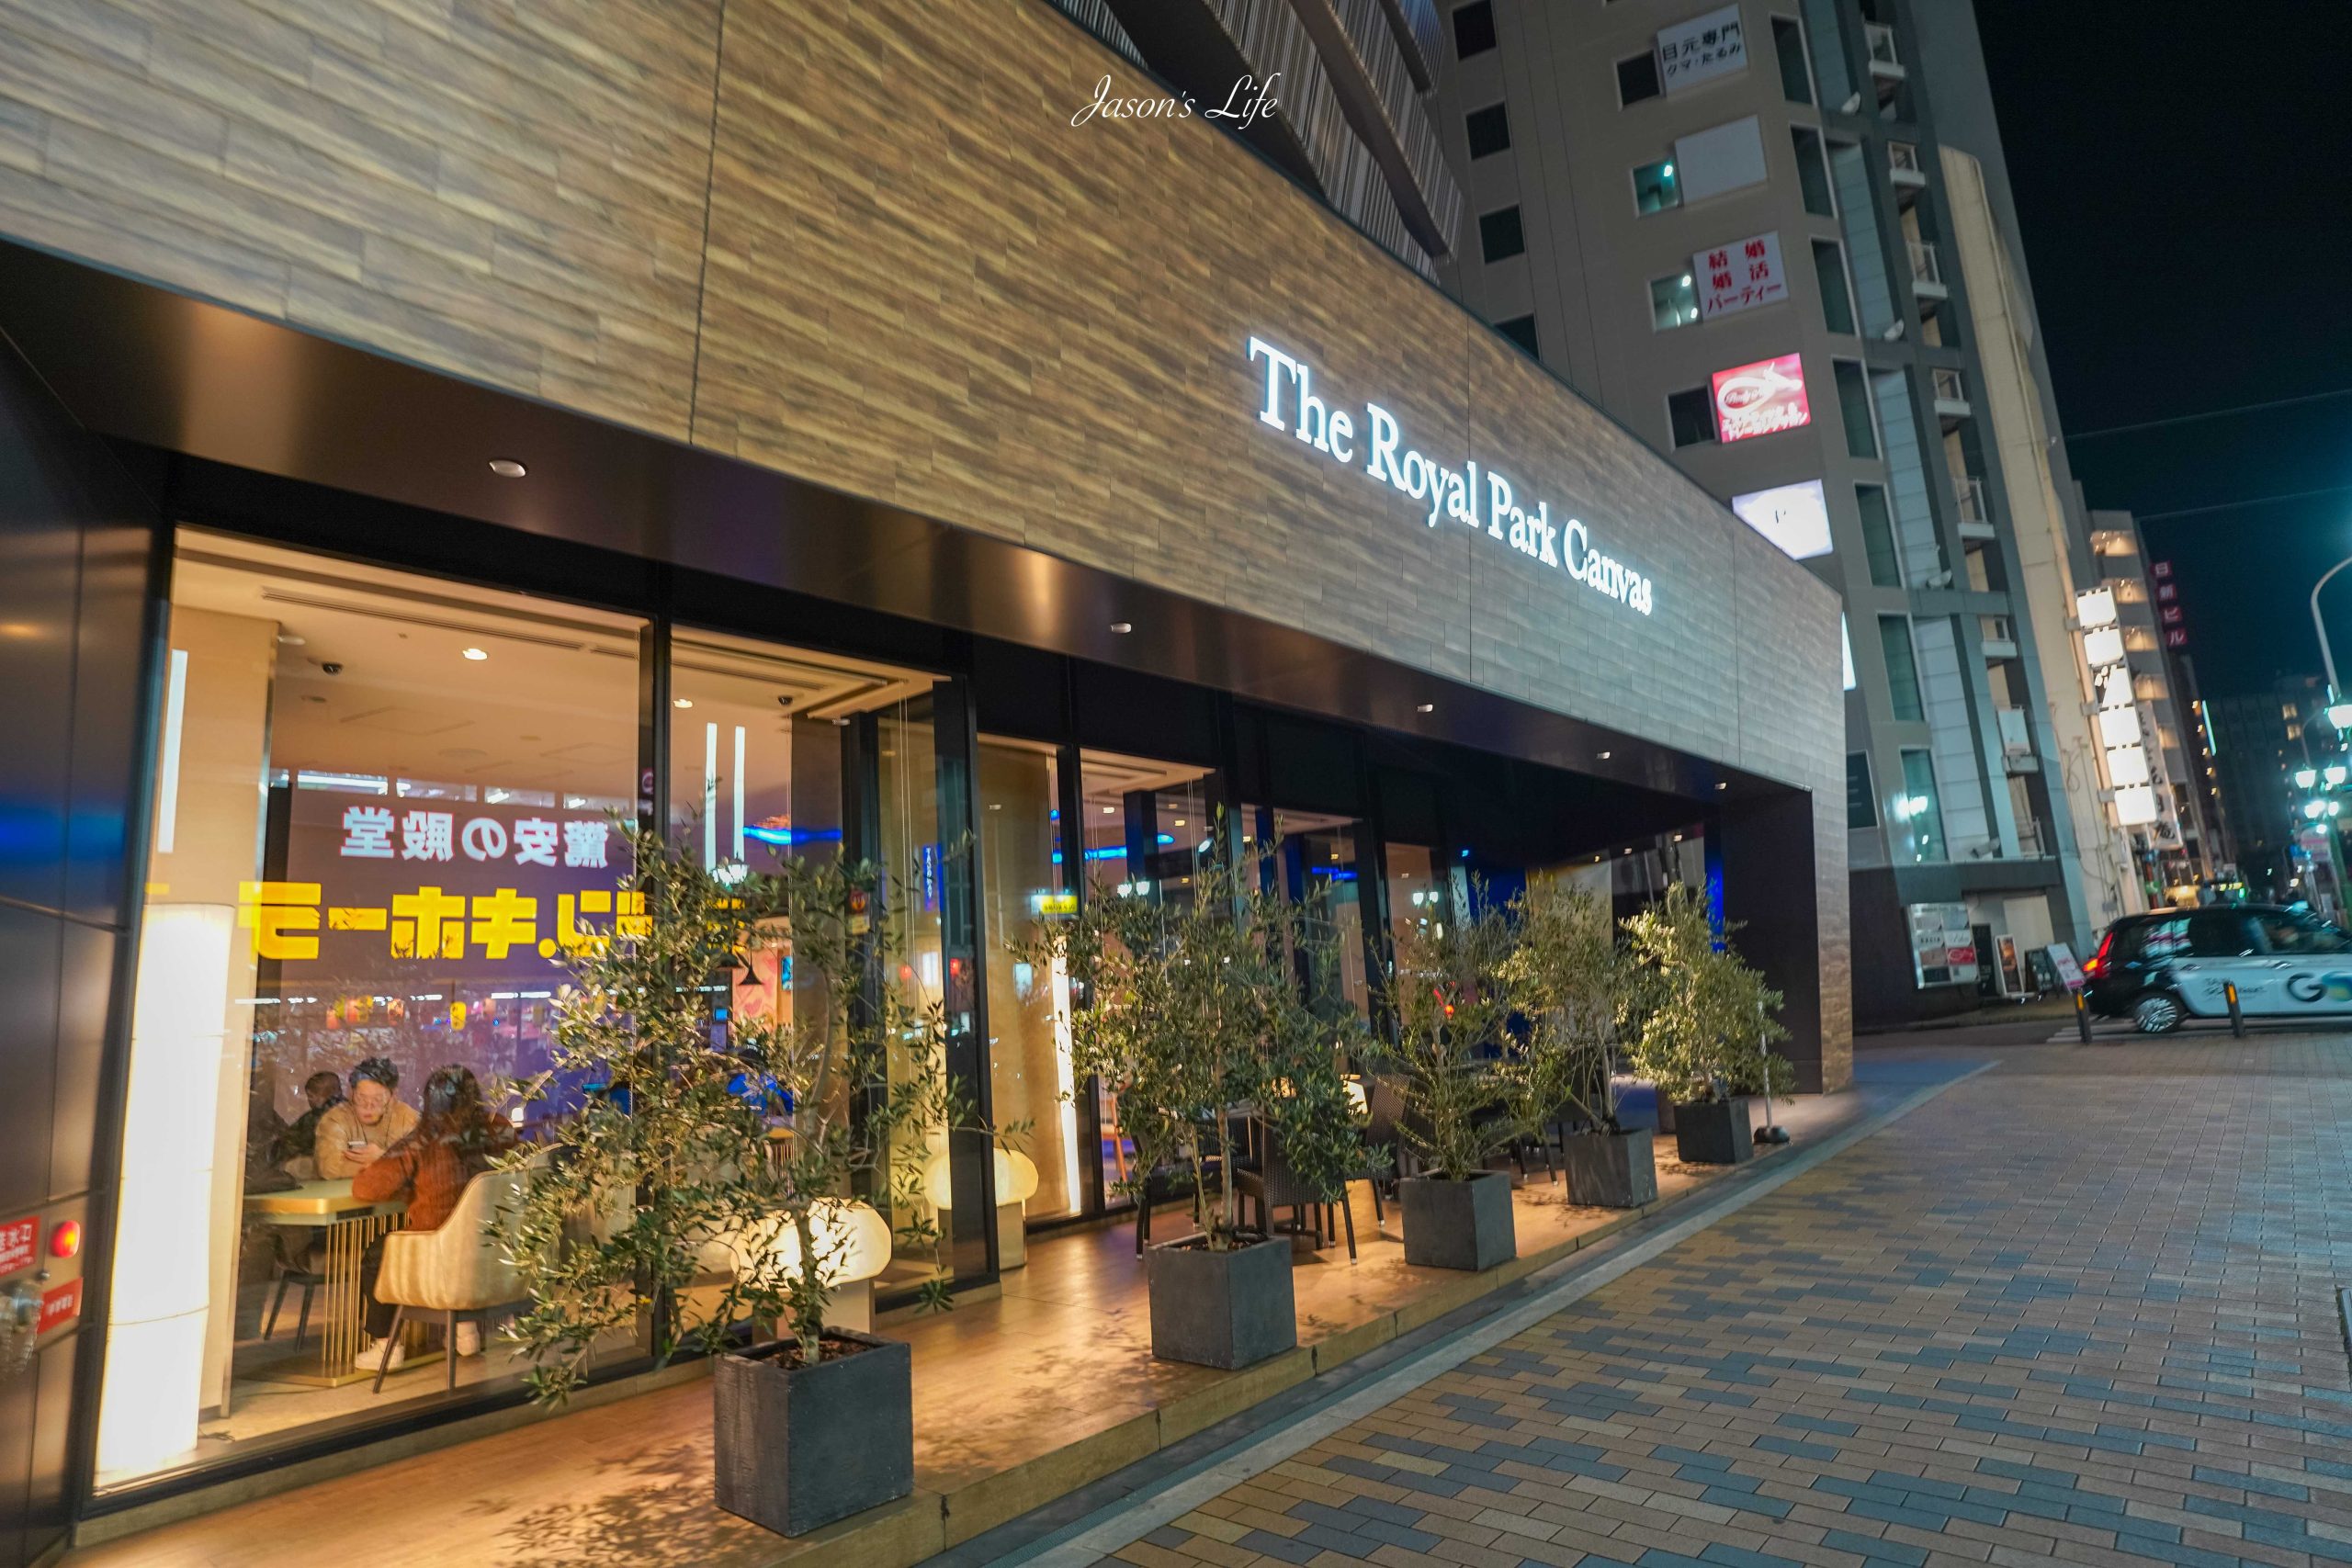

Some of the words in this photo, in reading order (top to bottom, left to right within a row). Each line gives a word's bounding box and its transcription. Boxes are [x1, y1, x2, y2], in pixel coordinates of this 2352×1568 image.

[1708, 284, 1781, 313] パーティー
[1250, 336, 1354, 463] The
[1366, 402, 1480, 528] Royal
[1487, 471, 1558, 569] Park
[1564, 519, 1654, 616] Canvas
